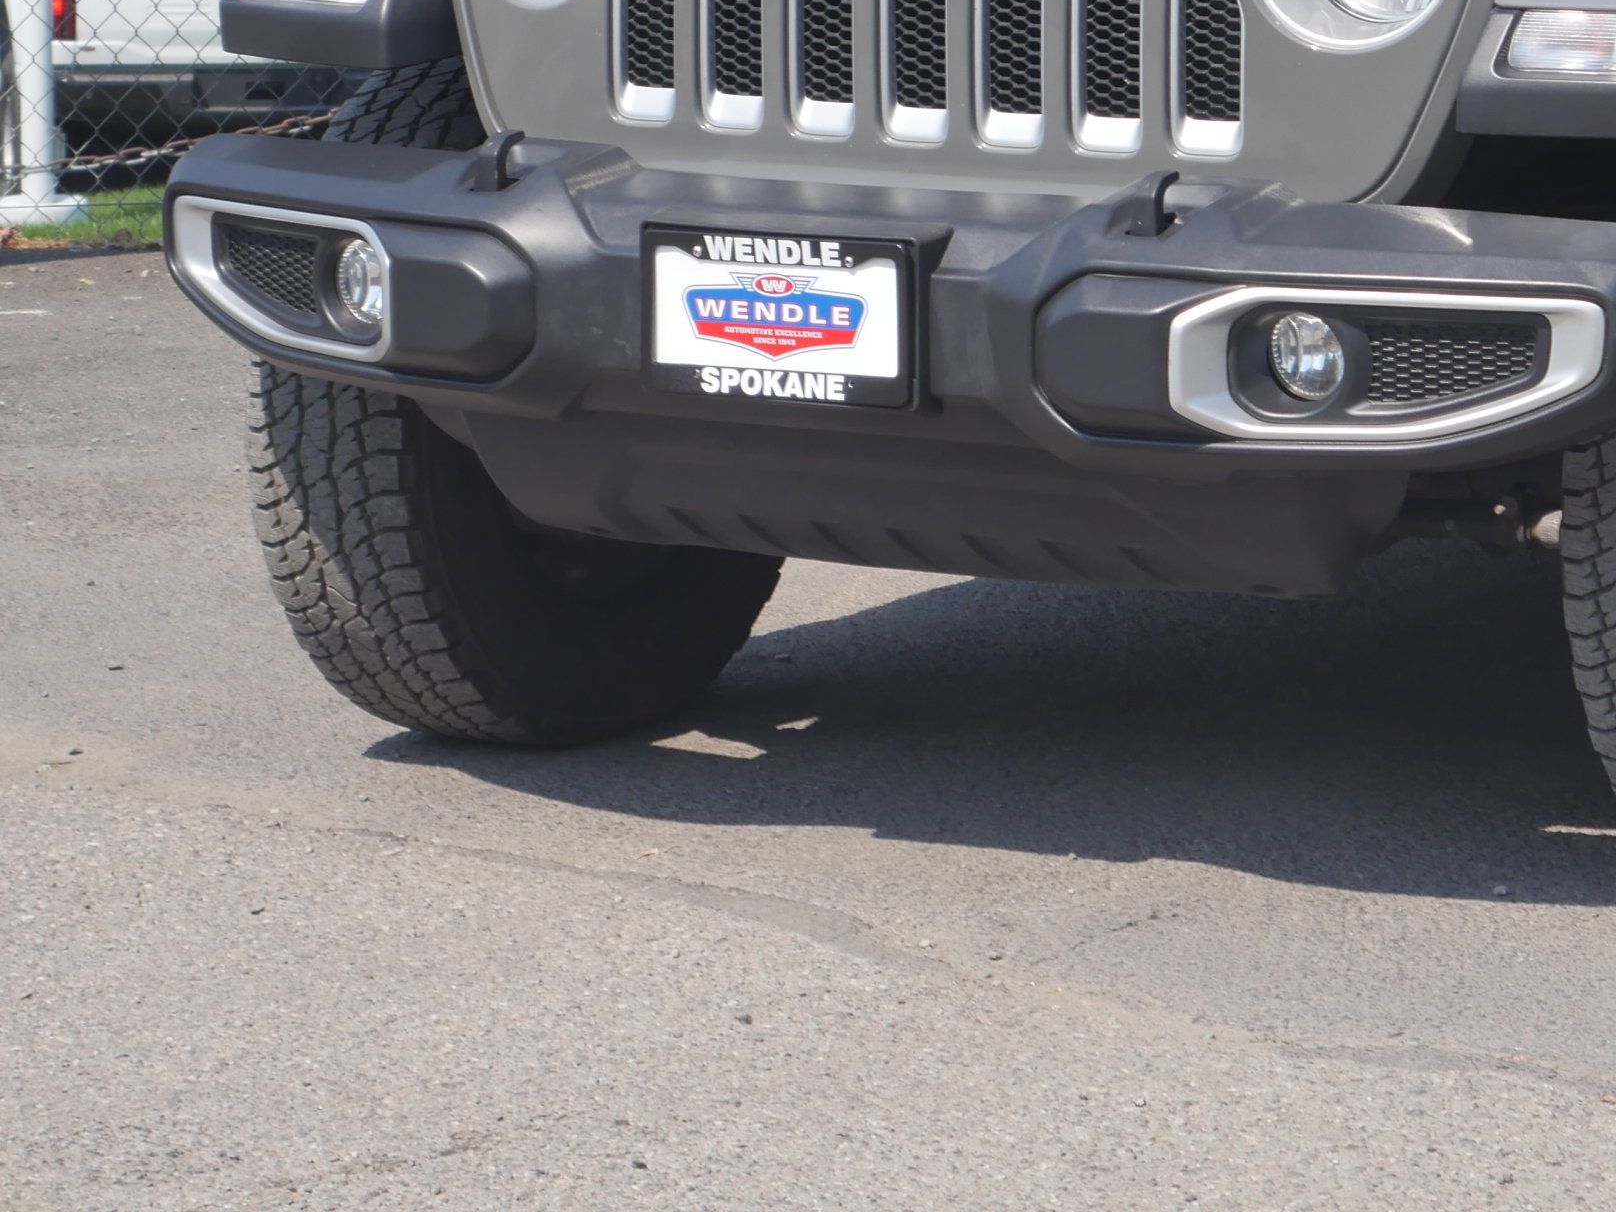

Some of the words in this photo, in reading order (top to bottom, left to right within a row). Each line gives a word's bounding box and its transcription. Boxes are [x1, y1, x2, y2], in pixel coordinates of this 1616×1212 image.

[703, 235, 842, 268] WENDLE
[696, 298, 850, 326] WENDLE
[724, 326, 773, 336] AUTOMOTIVE
[774, 329, 823, 339] EXCELLENCE
[753, 337, 777, 345] SINCE
[700, 366, 846, 401] SPOKANE
